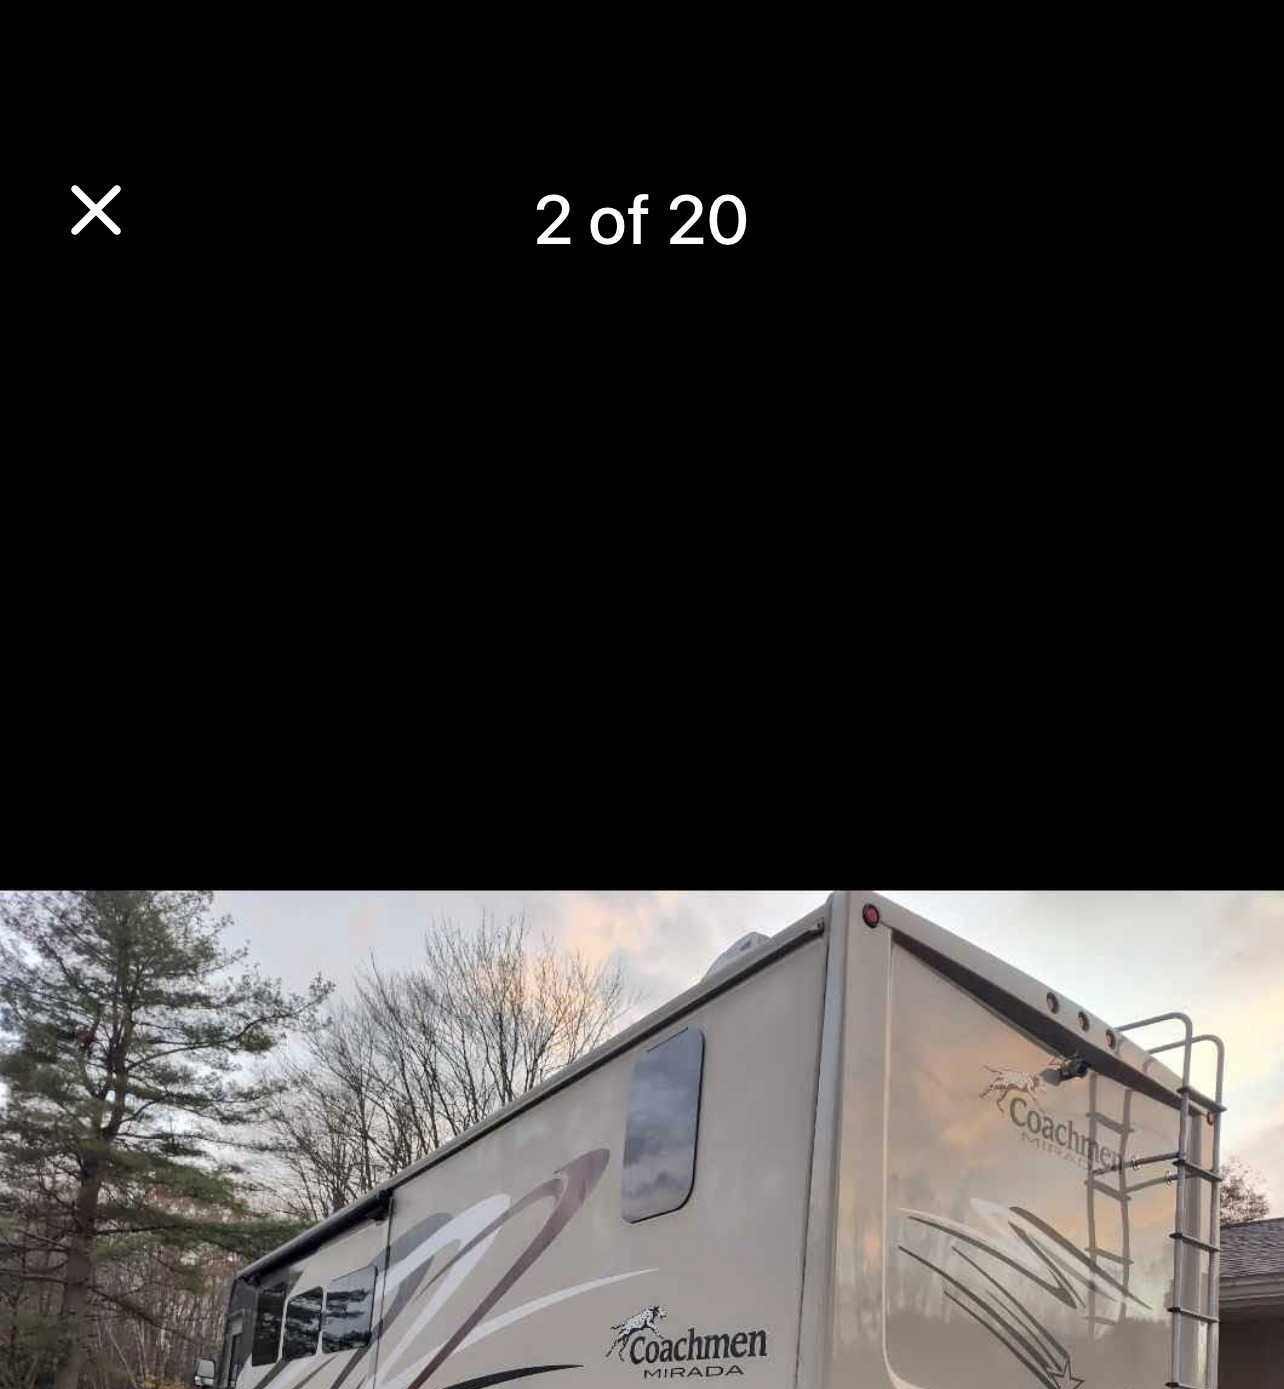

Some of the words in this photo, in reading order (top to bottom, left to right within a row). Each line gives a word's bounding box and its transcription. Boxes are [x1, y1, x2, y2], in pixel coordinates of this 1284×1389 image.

[1021, 1131, 1096, 1171] MIRAD
[629, 1327, 768, 1365] Coachmen
[643, 1364, 745, 1379] MIRADA
